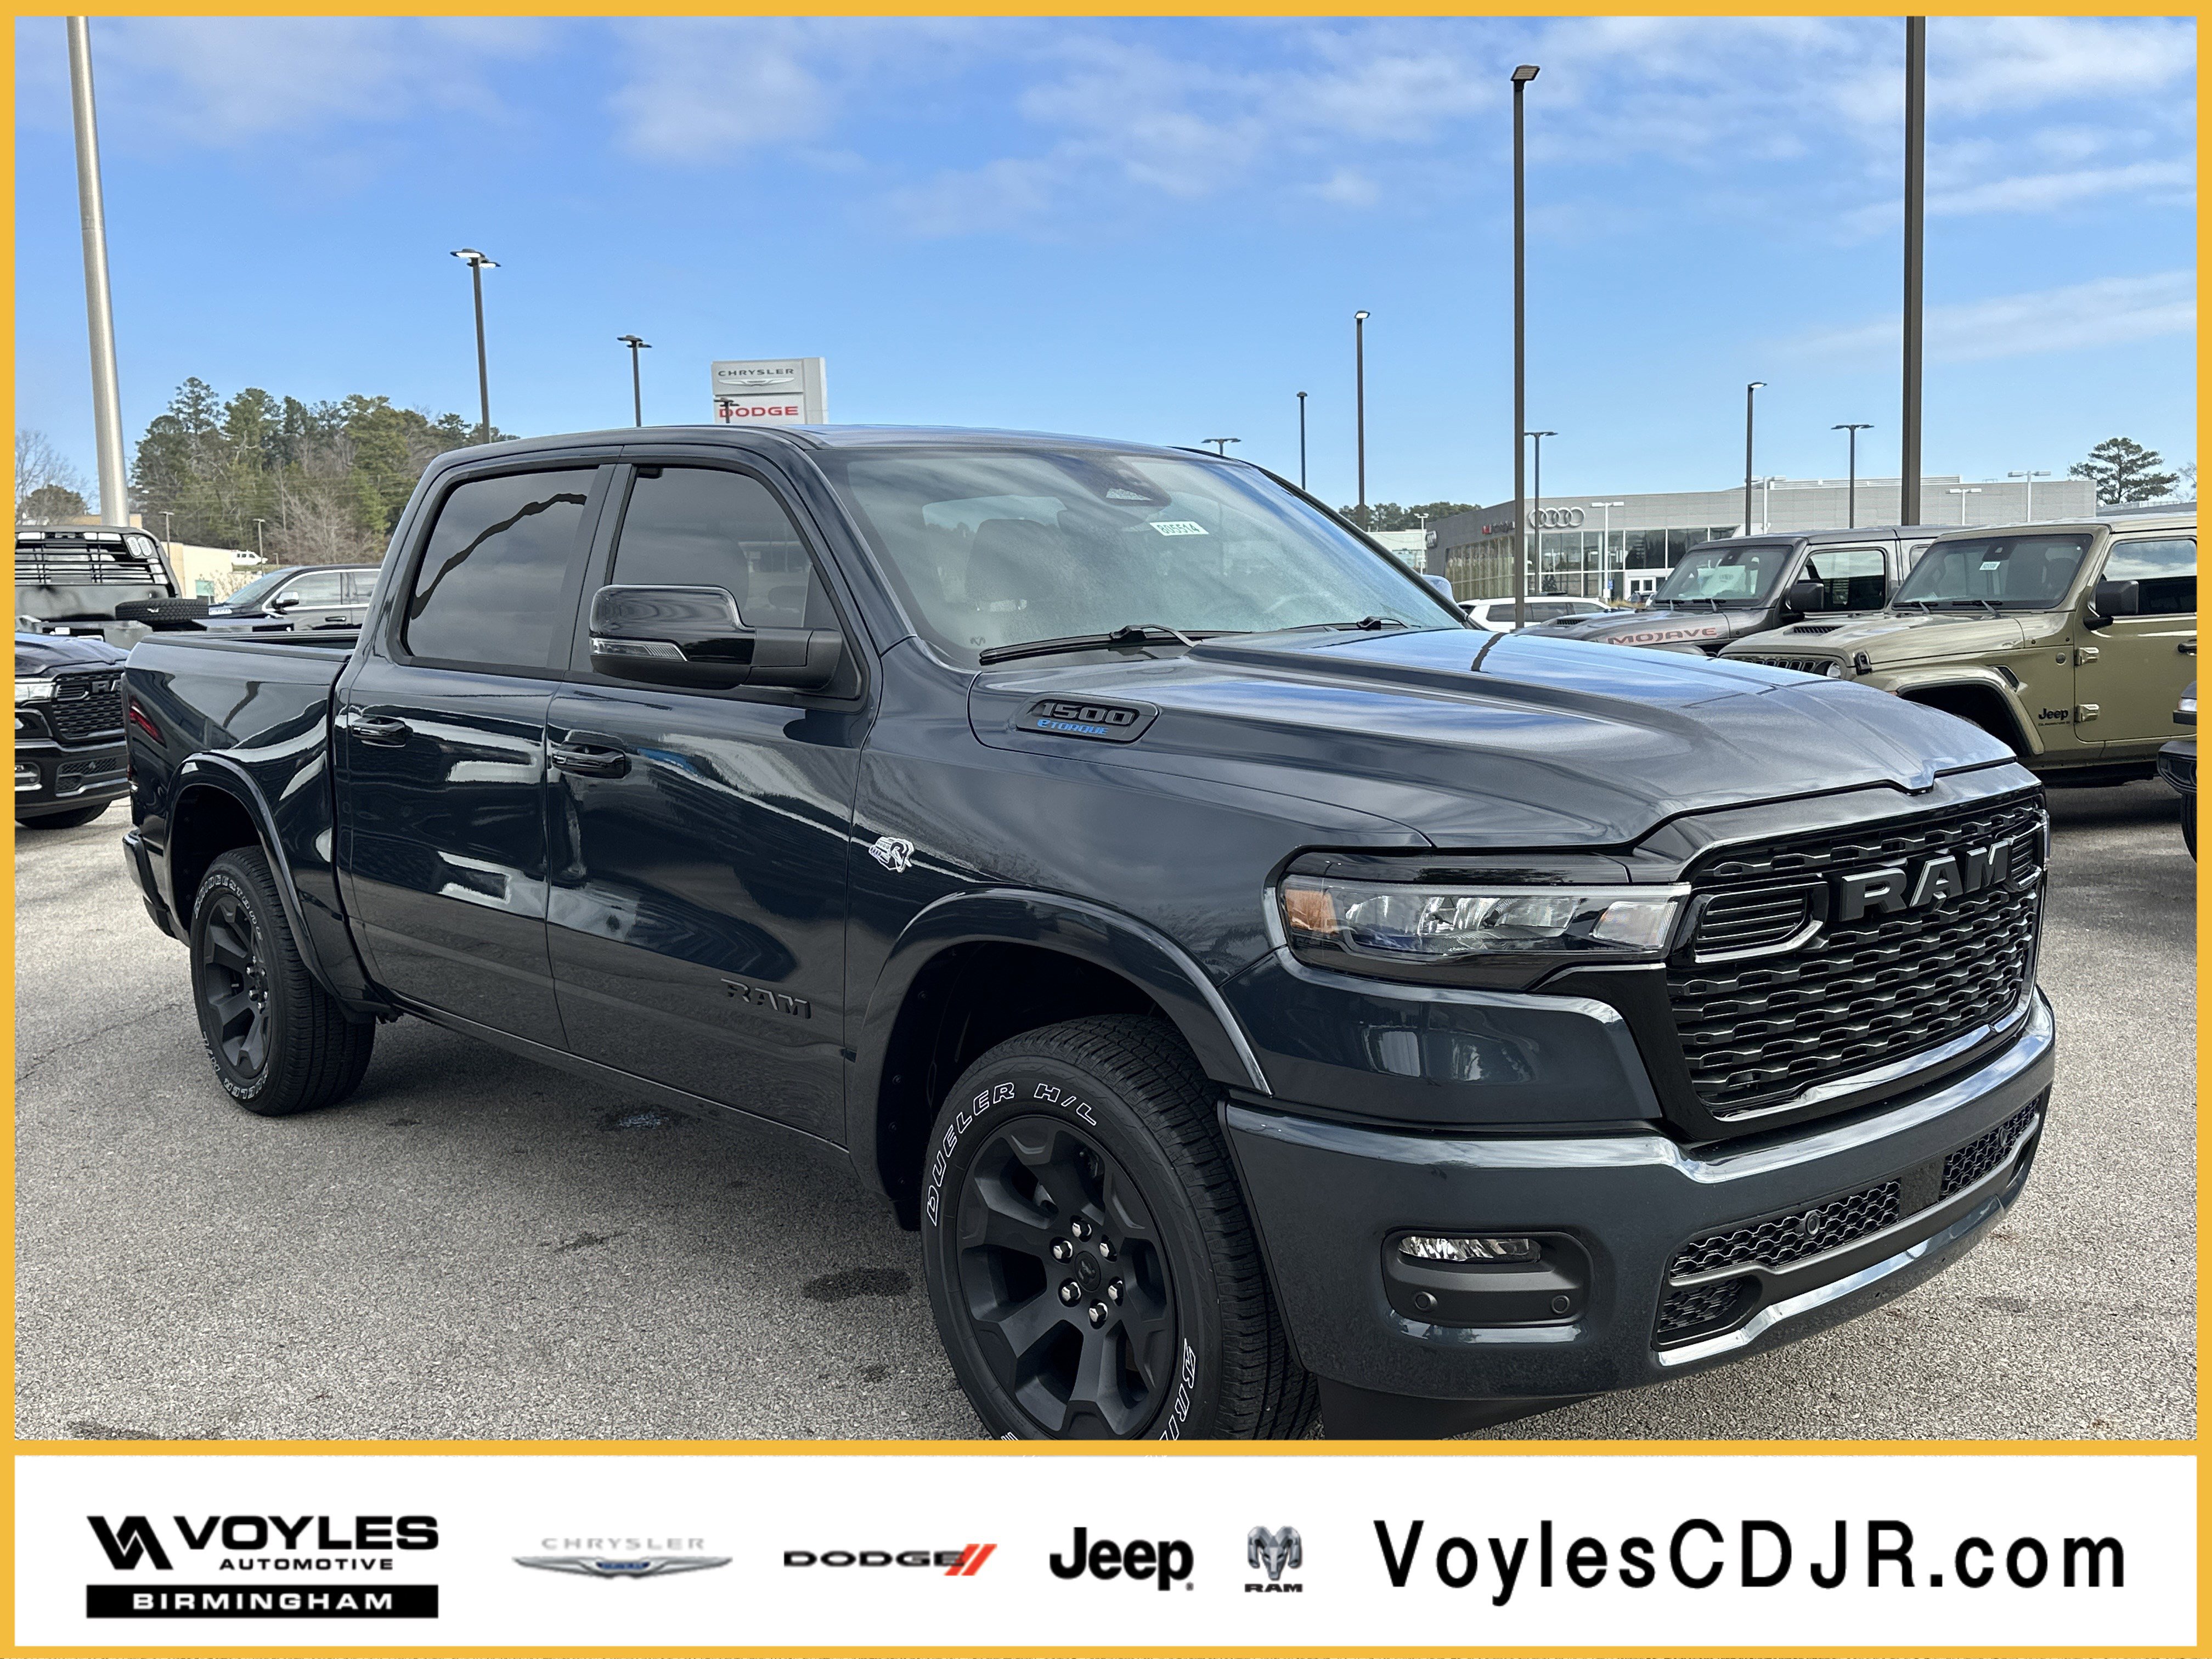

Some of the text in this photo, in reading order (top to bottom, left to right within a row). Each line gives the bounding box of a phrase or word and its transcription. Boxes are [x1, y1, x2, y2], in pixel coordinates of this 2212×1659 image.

[718, 368, 794, 376] CHRYSLER
[719, 406, 799, 418] DODGE
[1156, 523, 1200, 533] 805514
[1607, 628, 1717, 645] MOJAVE
[1042, 702, 1135, 725] 1500
[2038, 708, 2069, 720] Jeep
[1839, 840, 2009, 922] RAM
[721, 978, 812, 1019] RAM
[927, 1082, 1097, 1227] DUELER H/L
